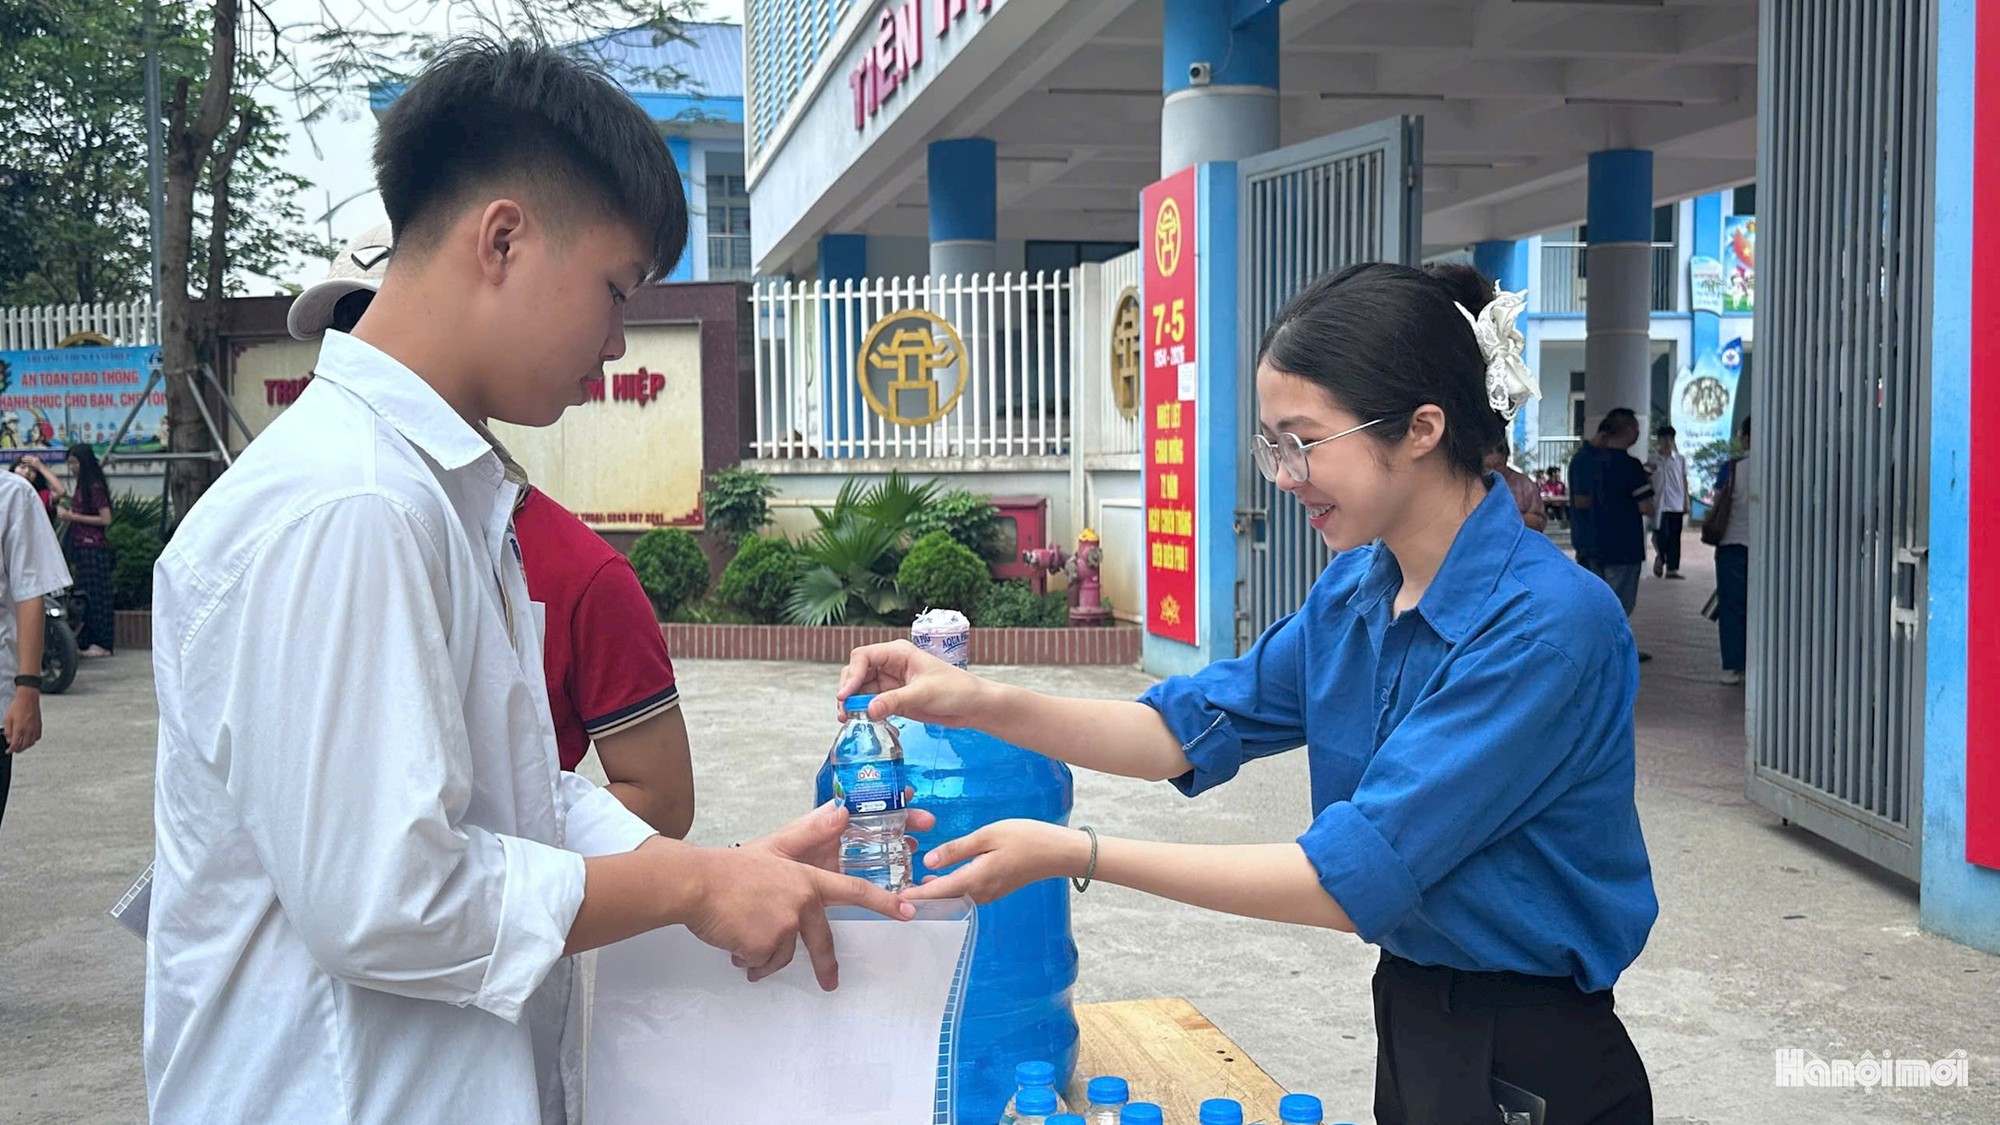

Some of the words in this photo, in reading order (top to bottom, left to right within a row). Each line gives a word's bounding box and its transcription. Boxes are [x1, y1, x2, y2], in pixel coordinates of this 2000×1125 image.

[22, 373, 37, 387] AN
[72, 371, 98, 386] GIAO
[612, 367, 665, 407] HIỆP
[64, 393, 87, 408] CHO
